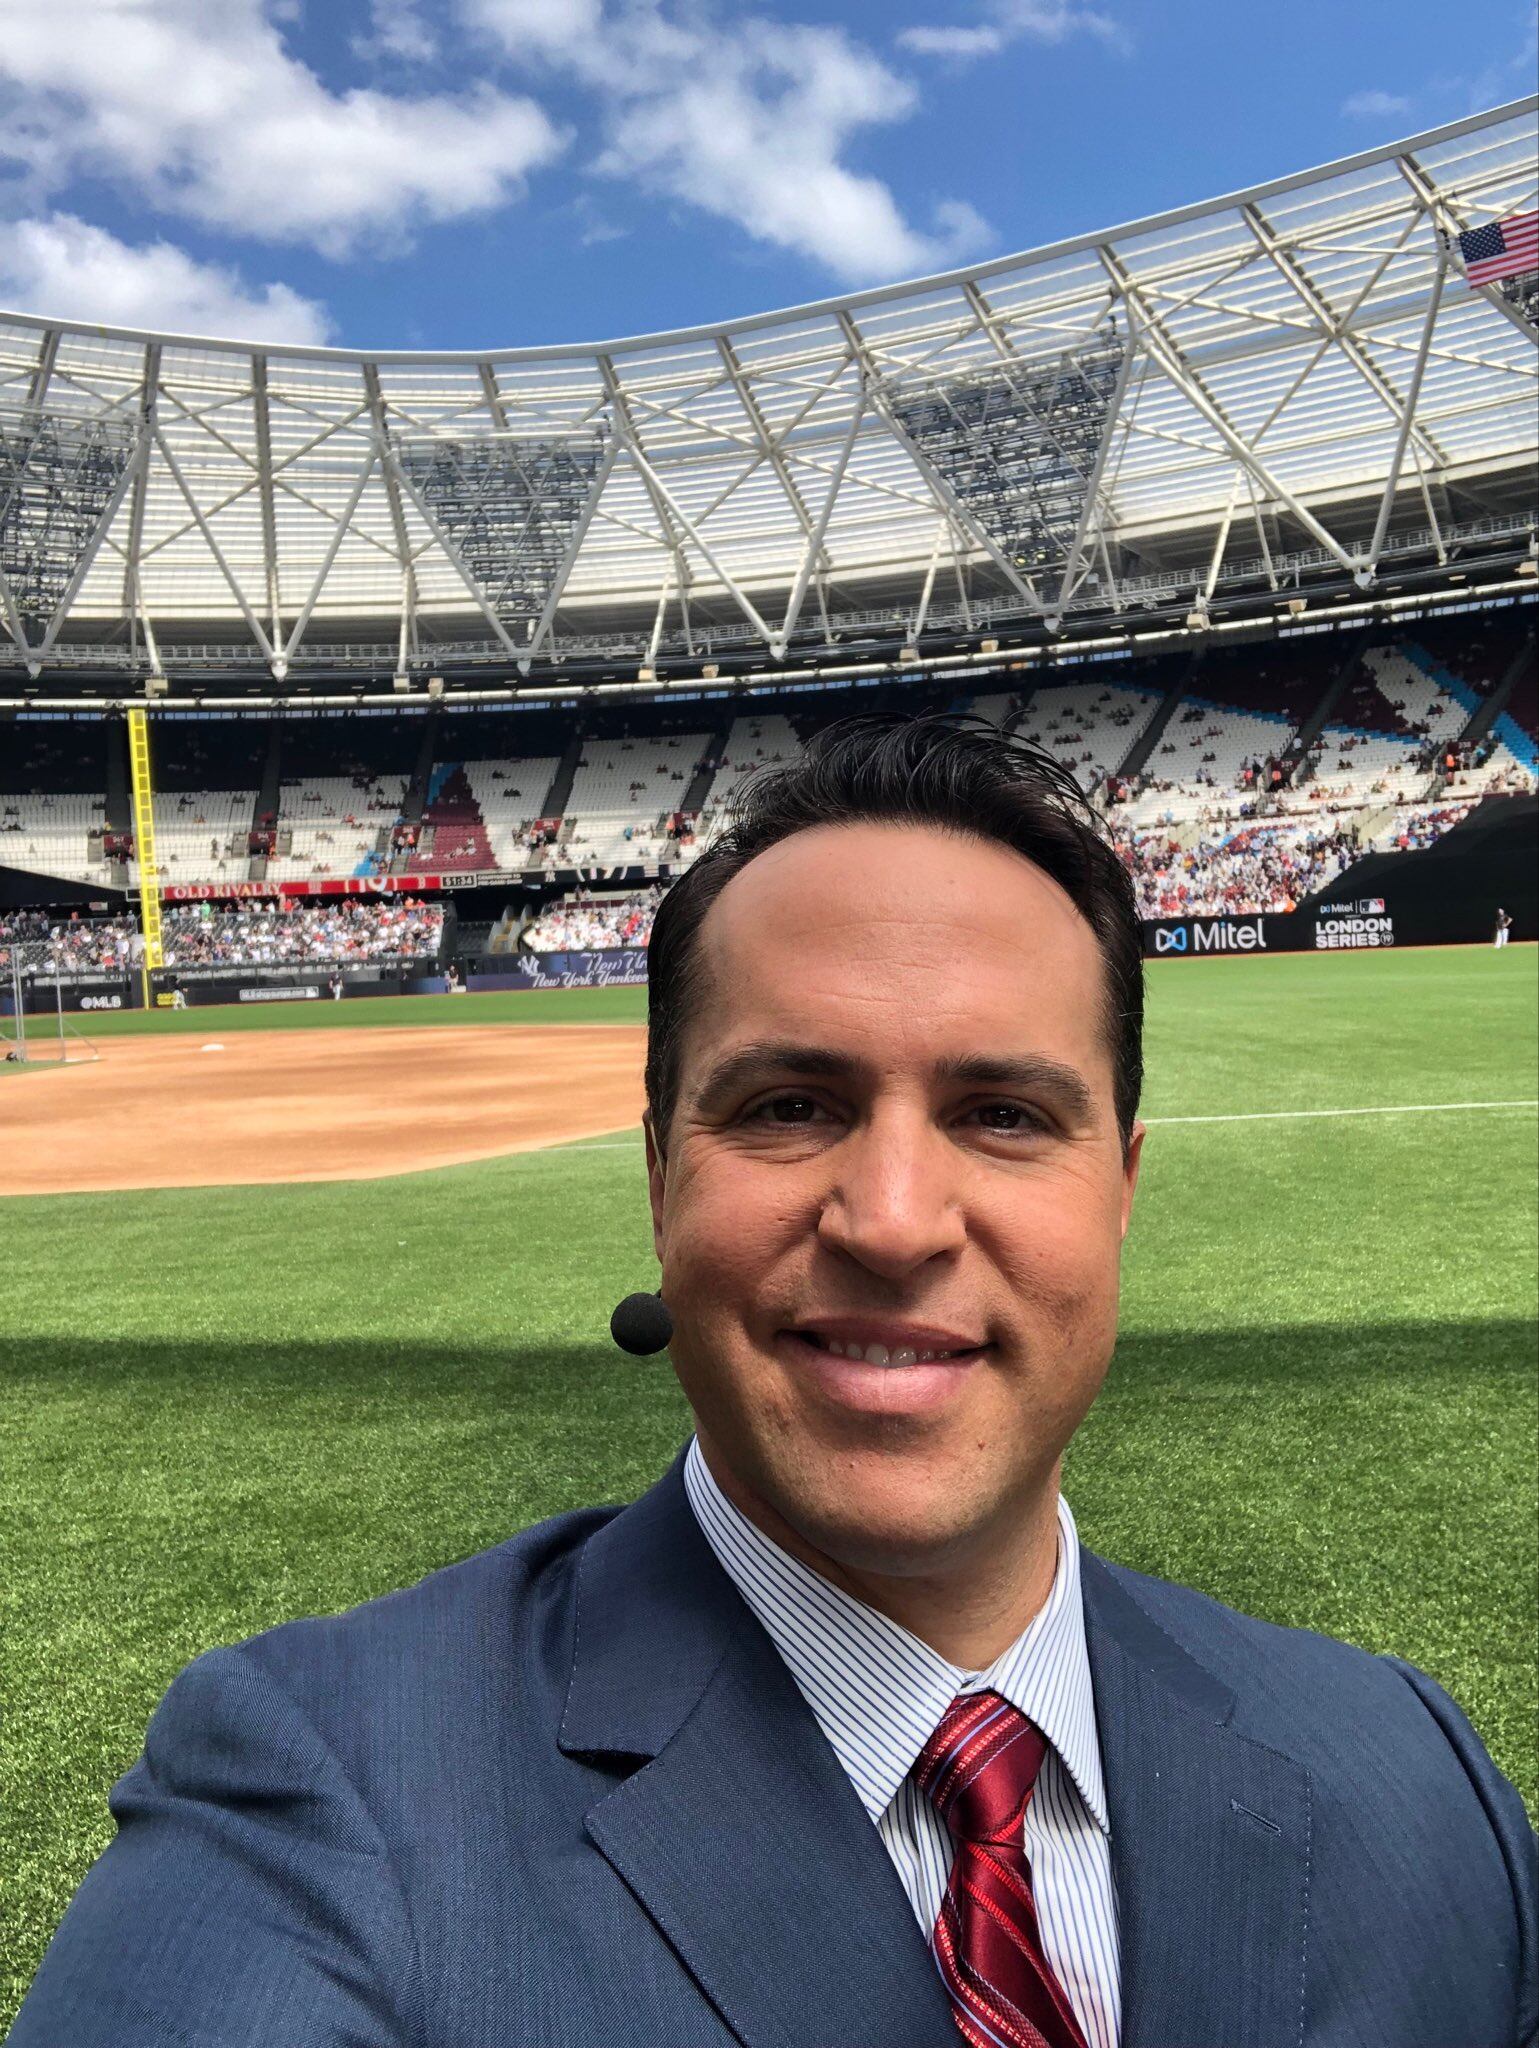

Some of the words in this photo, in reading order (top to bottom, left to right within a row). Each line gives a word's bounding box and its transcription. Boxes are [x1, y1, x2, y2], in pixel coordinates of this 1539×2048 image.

[173, 886, 210, 899] OLD
[213, 883, 281, 898] RIVALRY
[1331, 902, 1354, 913] Mitel
[1193, 918, 1267, 951] Mitel
[1315, 917, 1393, 935] LONDON
[1315, 932, 1380, 949] SERIES
[532, 972, 560, 988] New
[561, 970, 595, 989] York
[596, 968, 649, 988] Yankees
